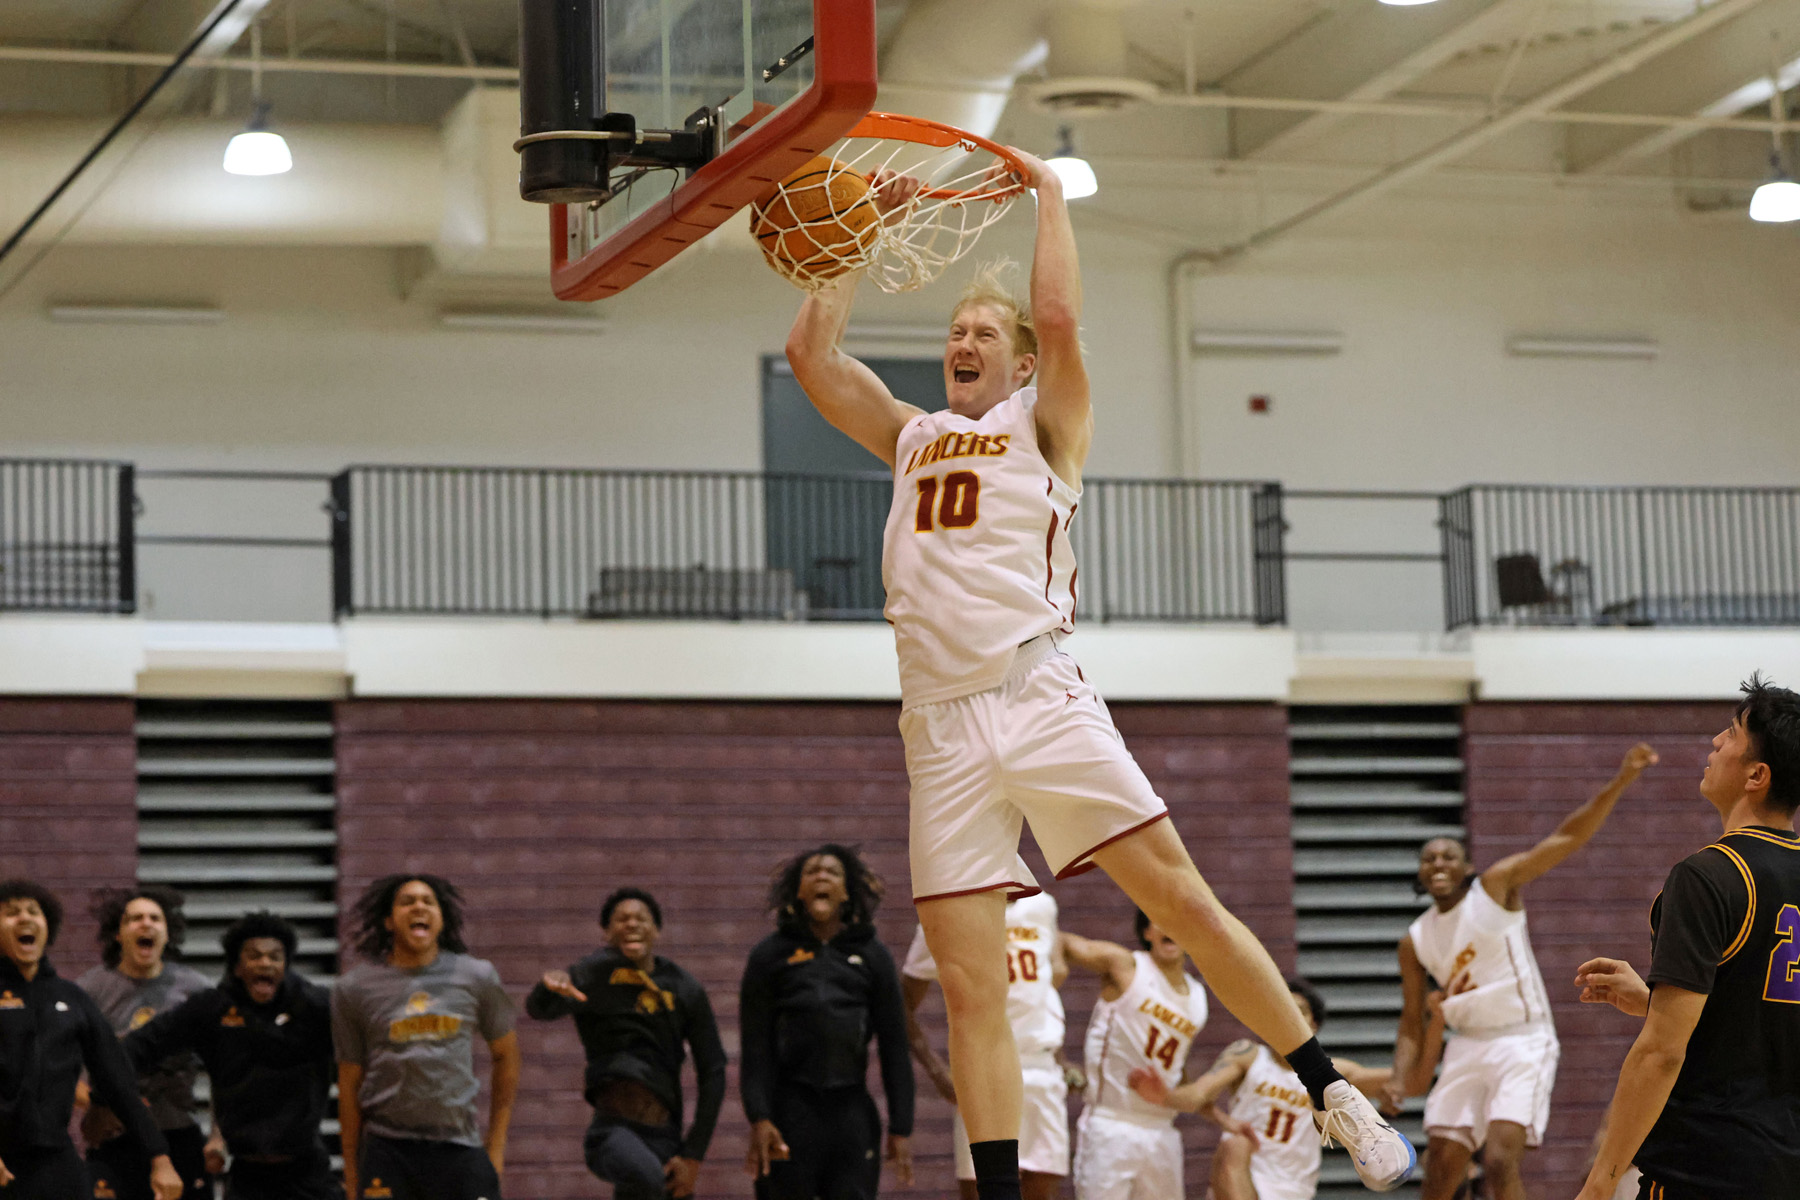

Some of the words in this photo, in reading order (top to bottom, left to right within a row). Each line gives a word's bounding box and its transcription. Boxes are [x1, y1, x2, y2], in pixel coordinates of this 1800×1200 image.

[904, 431, 1011, 477] LANCERS
[914, 469, 981, 534] 10
[1762, 903, 1800, 1004] 2
[1145, 1024, 1179, 1071] 14
[1265, 1104, 1298, 1143] 11
